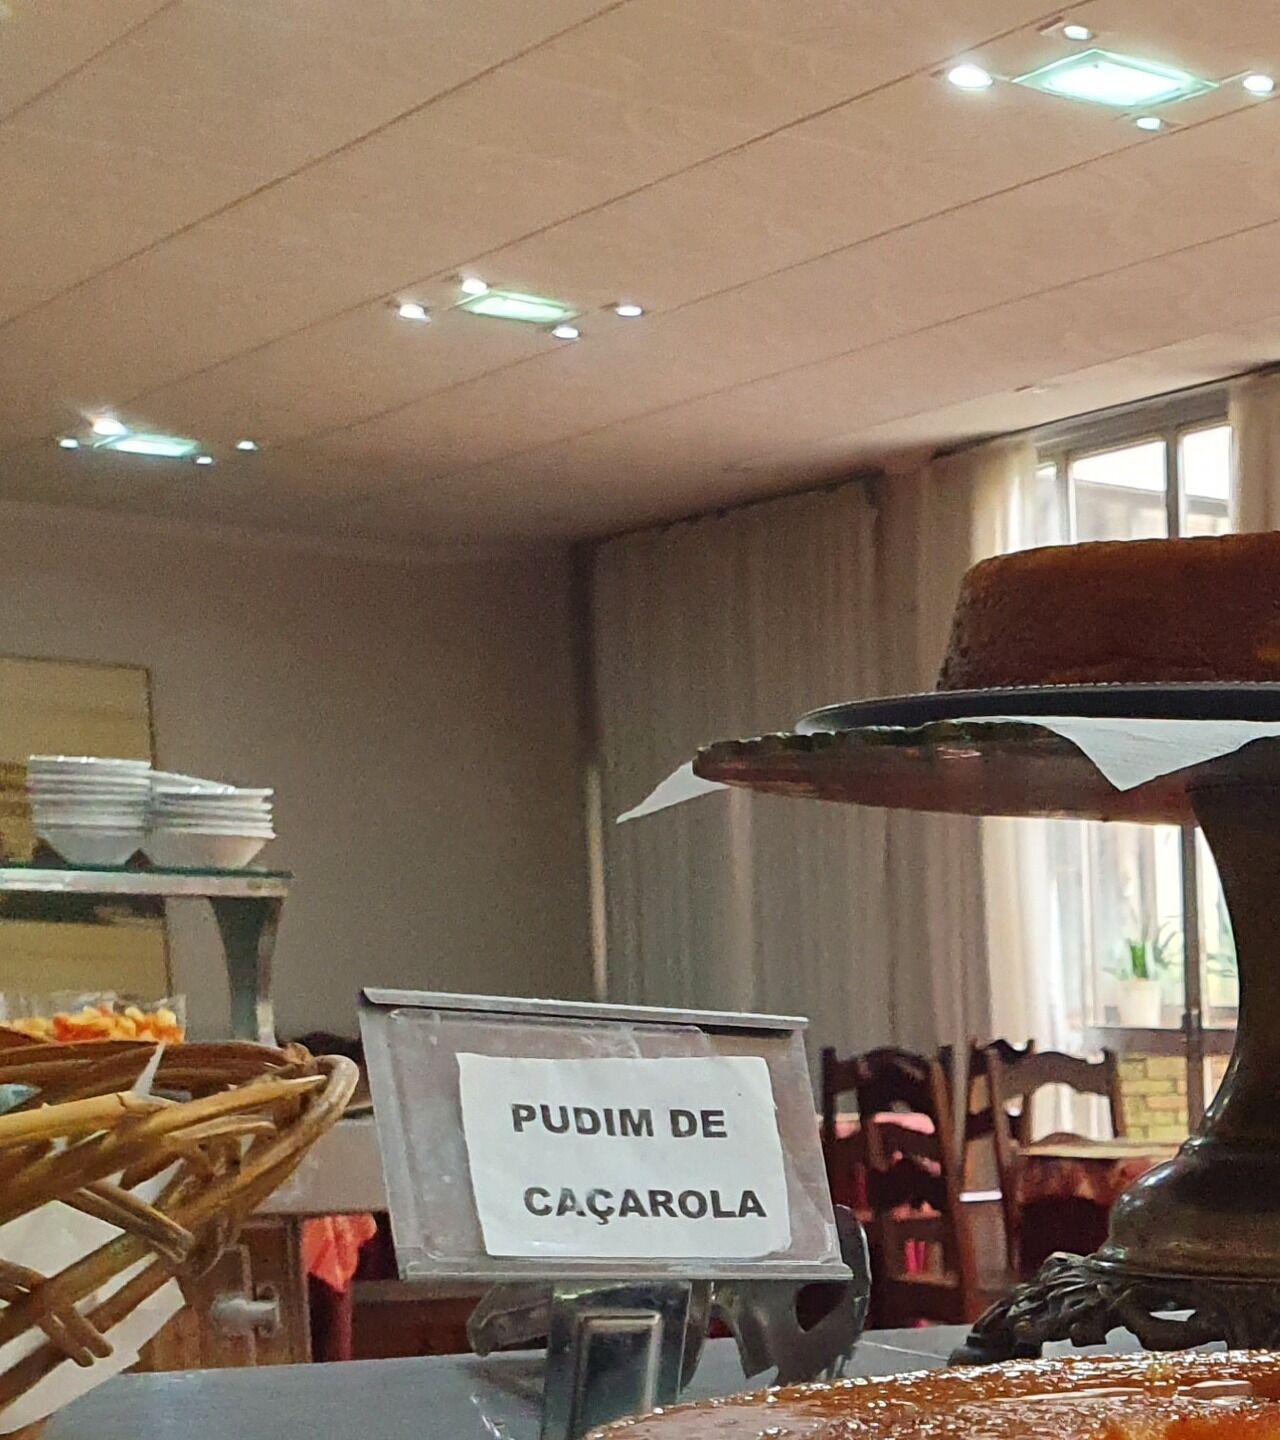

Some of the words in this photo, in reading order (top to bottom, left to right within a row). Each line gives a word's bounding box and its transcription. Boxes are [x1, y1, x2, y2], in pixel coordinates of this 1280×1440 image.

[511, 1103, 654, 1138] PUDIM
[670, 1109, 728, 1139] DE
[523, 1185, 768, 1225] CAÇAROLA
